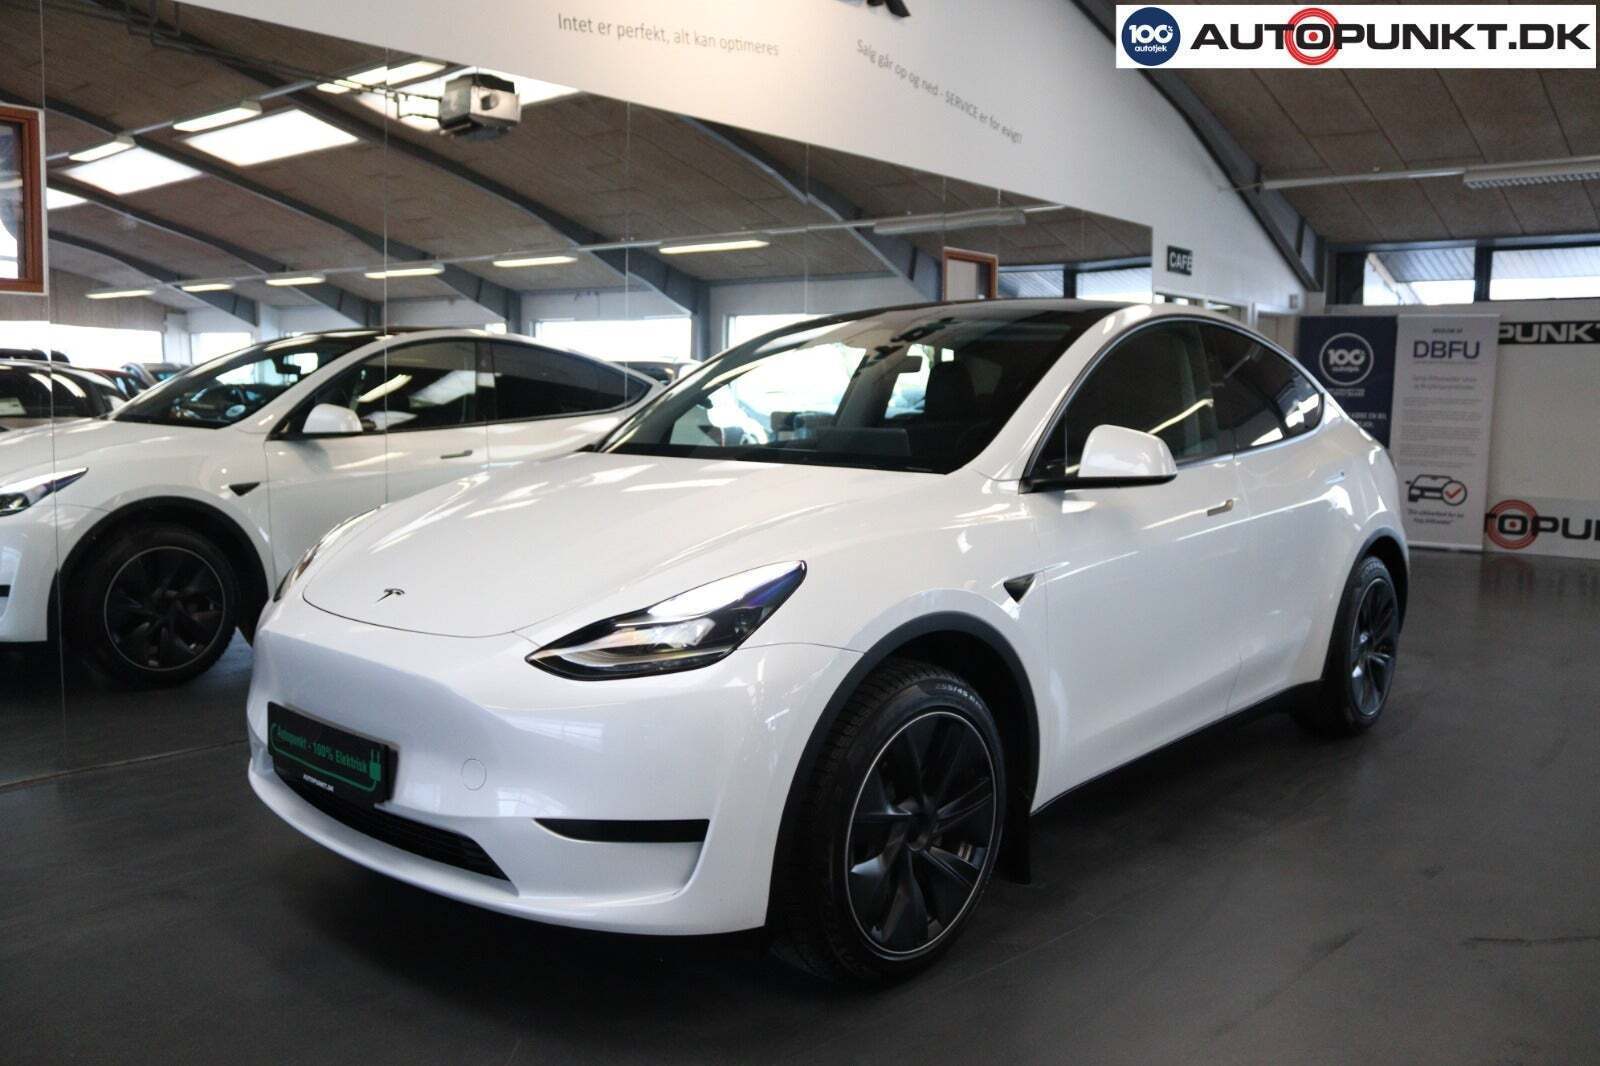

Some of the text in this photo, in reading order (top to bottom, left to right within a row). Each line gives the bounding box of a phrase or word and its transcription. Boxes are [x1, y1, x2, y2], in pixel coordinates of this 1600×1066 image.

[557, 13, 779, 56] Intet er perfekt, alt kan optimeres
[857, 39, 876, 64] Salg
[895, 64, 907, 79] op
[908, 72, 920, 89] og
[922, 79, 938, 96] ned
[945, 90, 978, 119] SERVICE
[979, 112, 988, 124] er
[990, 115, 1001, 131] for
[1499, 322, 1600, 343] PUNK
[1413, 340, 1480, 360] DBFU
